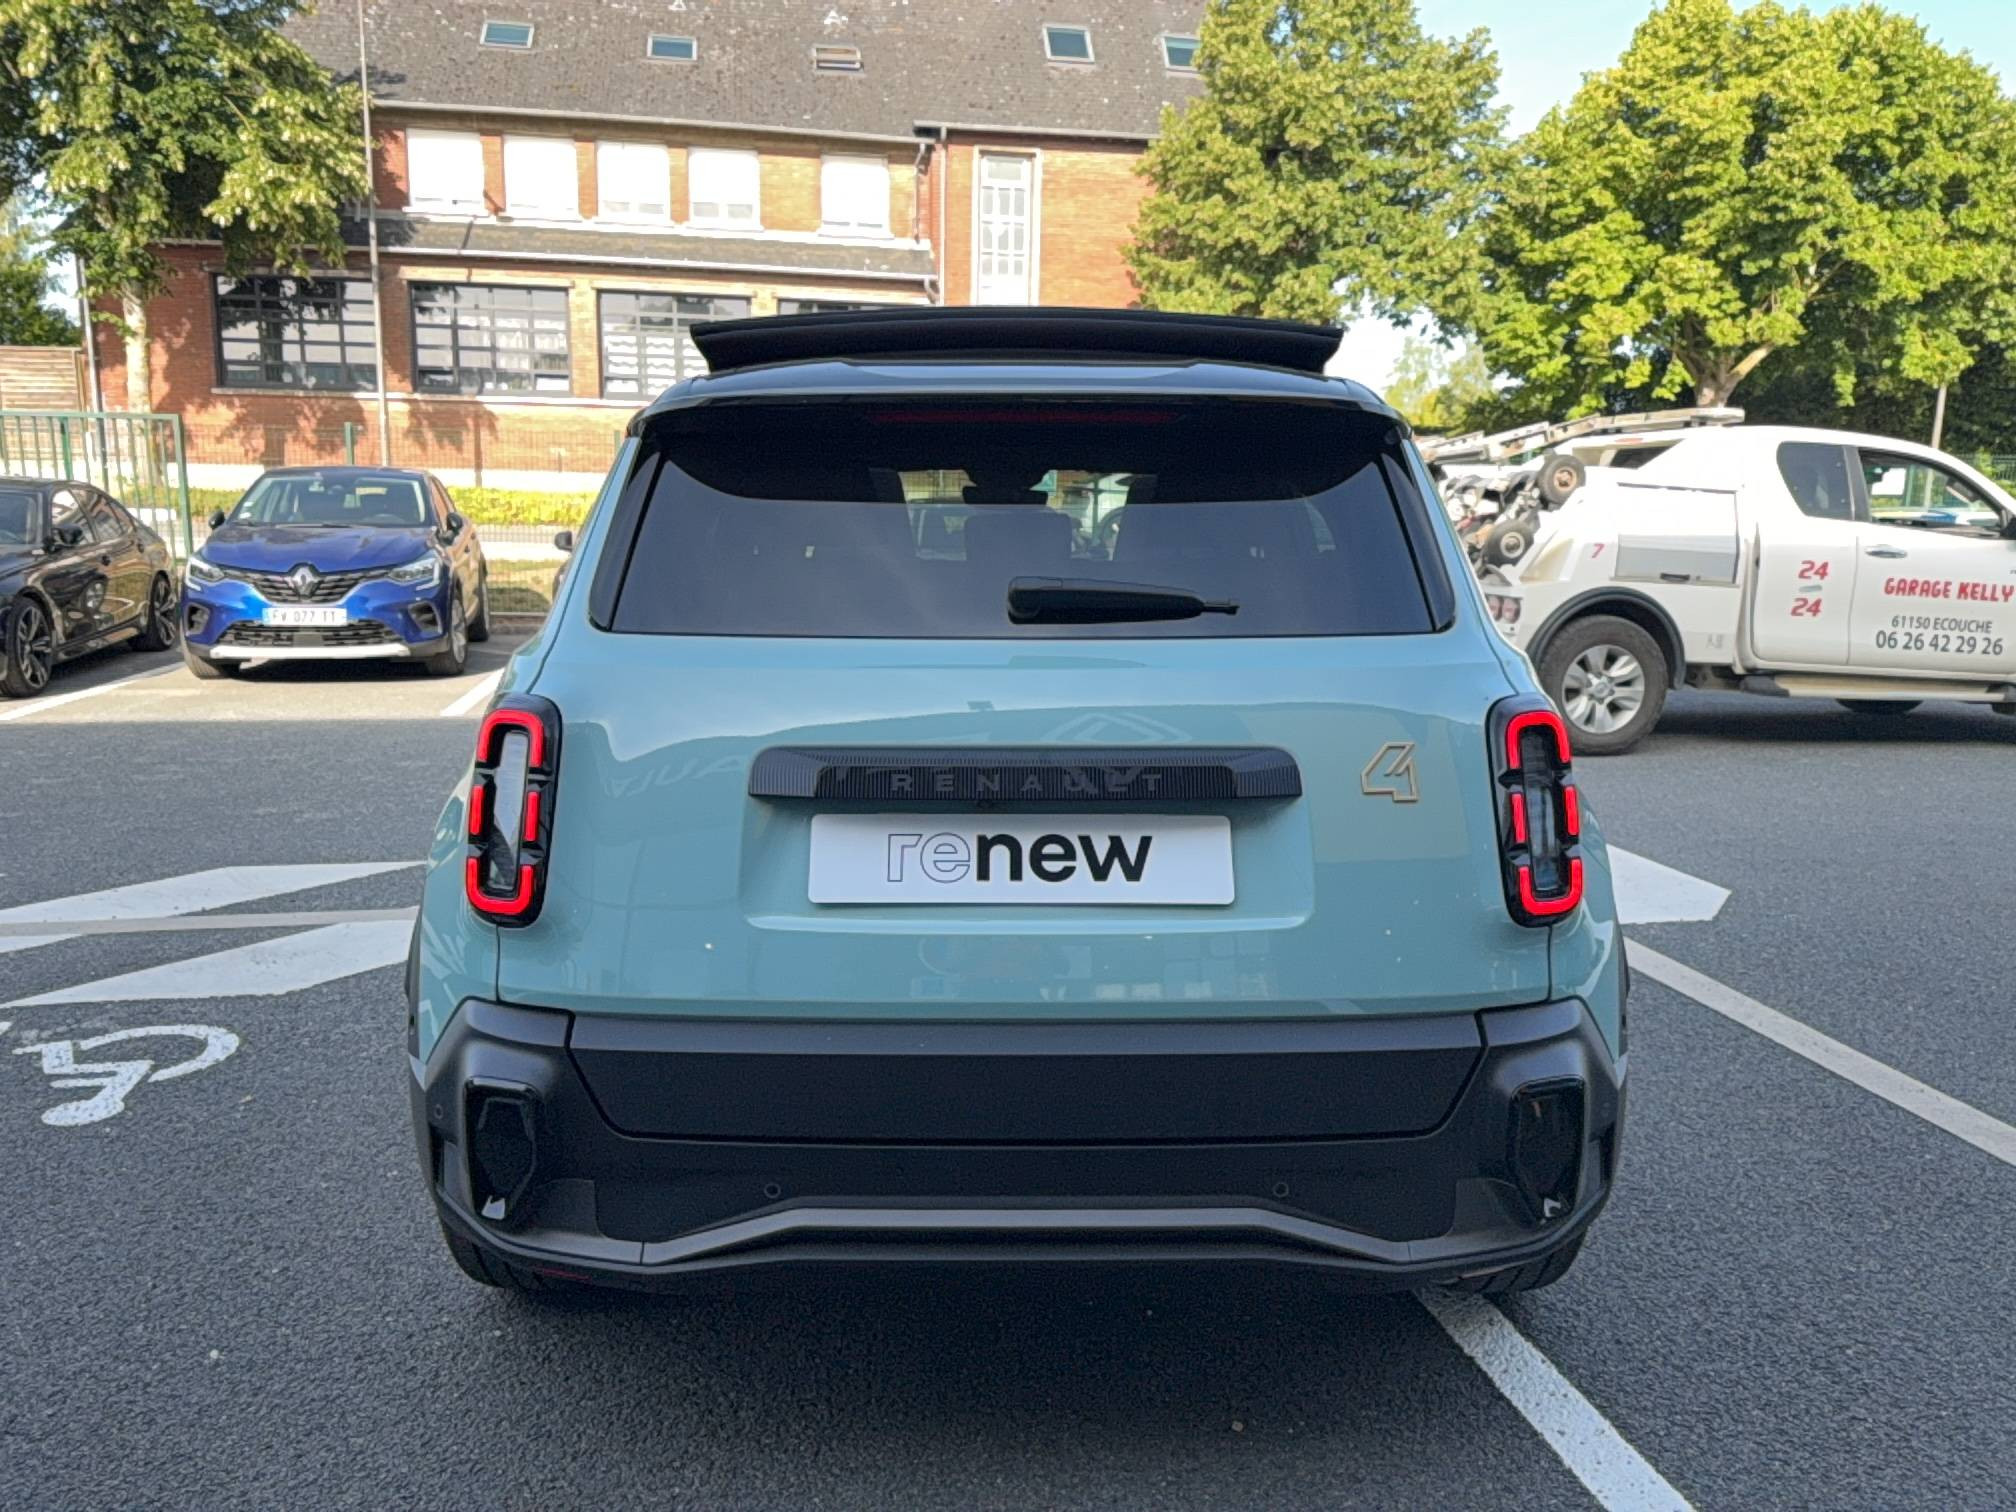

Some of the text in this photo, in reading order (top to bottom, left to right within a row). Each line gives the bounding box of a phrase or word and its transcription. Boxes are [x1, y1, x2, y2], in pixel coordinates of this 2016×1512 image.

[1591, 543, 1606, 559] 7
[1798, 560, 1829, 580] 24
[1884, 577, 2015, 603] GARAGE KELLY
[1791, 597, 1822, 617] 24
[1891, 614, 1993, 634] 61150 ECOUCHE
[1875, 629, 2004, 656] 06 26 42 29 26
[890, 772, 1162, 793] RENAULT
[1360, 741, 1418, 803] 4
[887, 832, 1153, 883] renew
